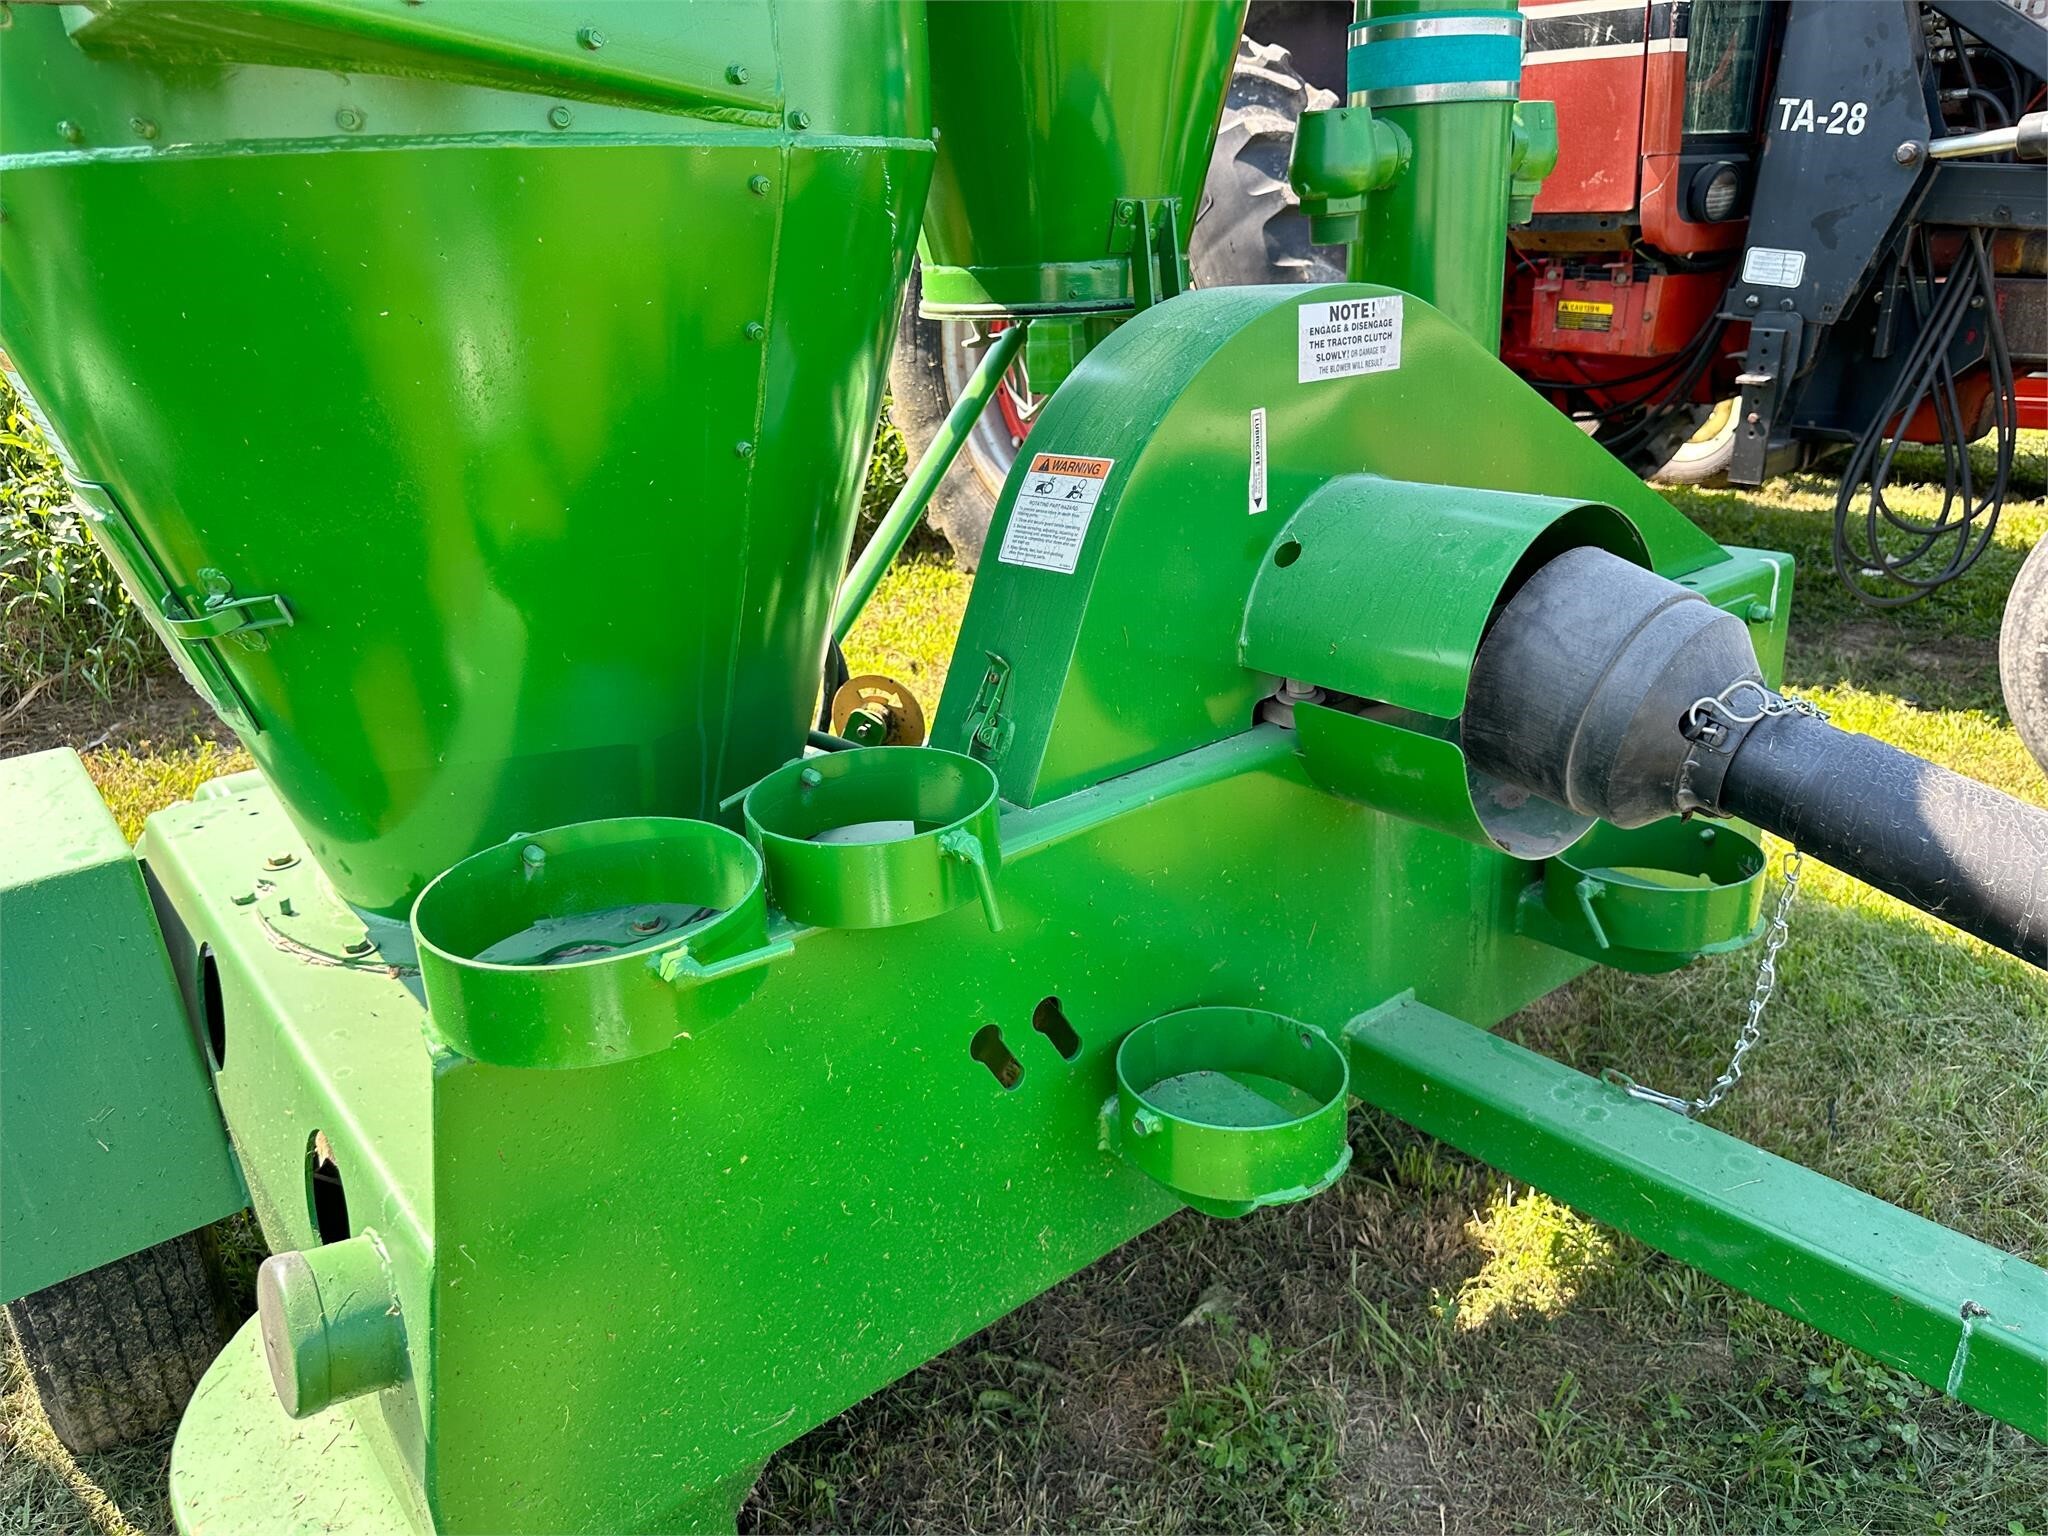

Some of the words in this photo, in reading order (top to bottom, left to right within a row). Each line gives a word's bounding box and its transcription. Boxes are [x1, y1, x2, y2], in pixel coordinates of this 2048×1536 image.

[1779, 97, 1868, 136] TA-28
[1329, 302, 1376, 322] NOTE!
[1309, 324, 1341, 336] ENGAGE
[1343, 323, 1349, 333] &
[1351, 318, 1393, 331] DISENGAGE
[1309, 340, 1325, 349] THE
[1327, 335, 1362, 347] TRACTOR
[1363, 331, 1393, 343] CLUTCH
[1316, 350, 1350, 362] SLOWLY!
[1350, 349, 1358, 358] OR
[1359, 346, 1378, 357] DAMAGE
[1379, 345, 1386, 354] TO
[1319, 366, 1329, 375] THE
[1329, 363, 1351, 373] BLOWER
[1352, 361, 1364, 370] WILL
[1052, 460, 1102, 475] WARNING
